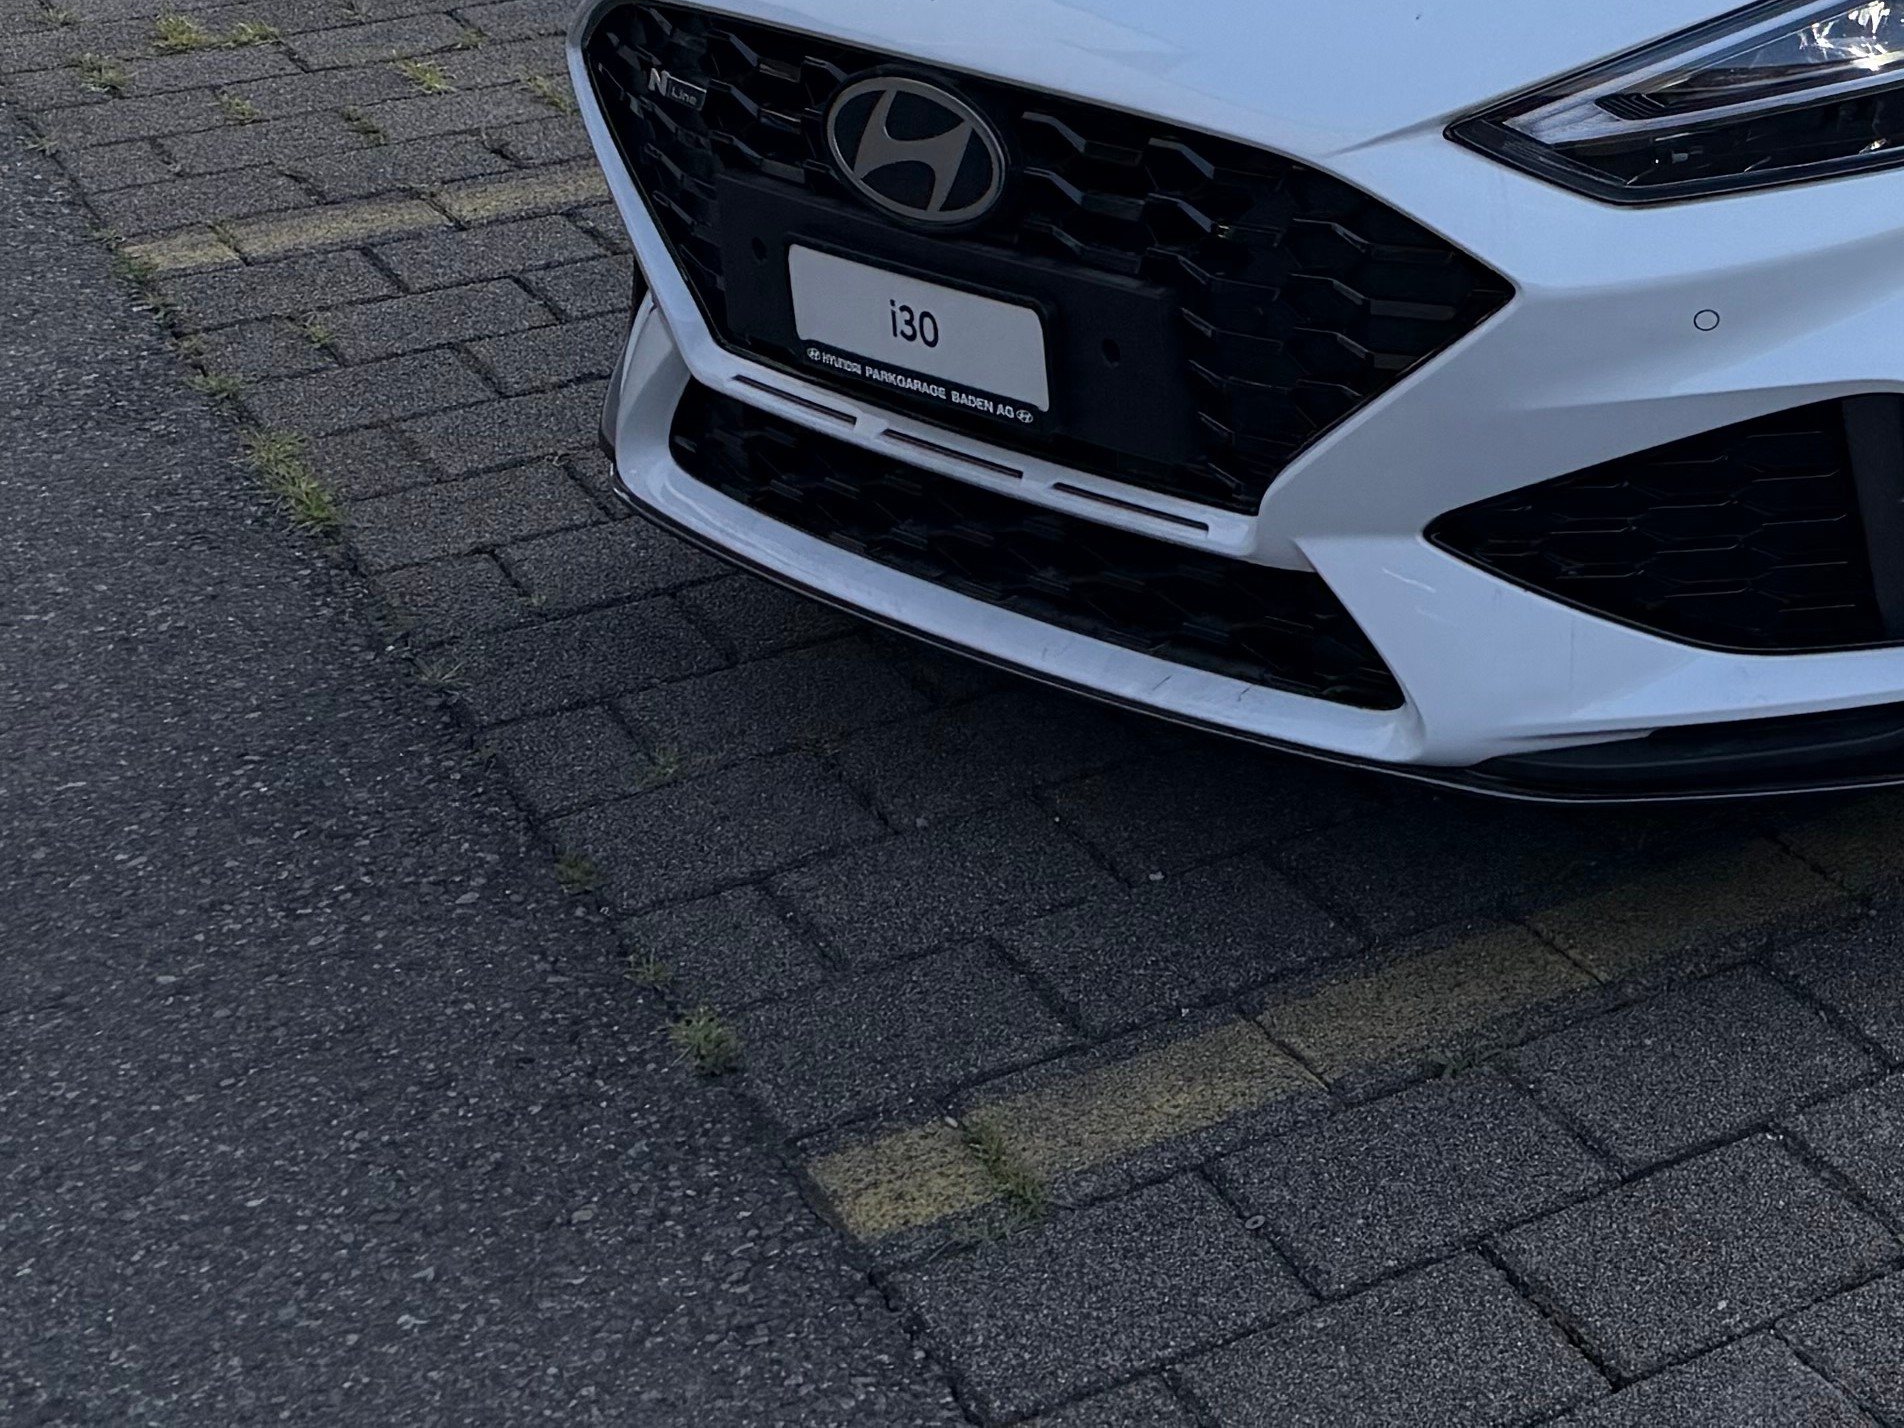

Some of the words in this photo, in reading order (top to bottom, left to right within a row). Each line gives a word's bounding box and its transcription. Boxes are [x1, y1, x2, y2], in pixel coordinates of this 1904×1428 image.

[889, 298, 940, 349] i30
[821, 351, 862, 376] HYUNDAI
[865, 365, 947, 400] PARKGARAGE
[951, 390, 994, 415] BADEN
[996, 403, 1015, 419] AG
